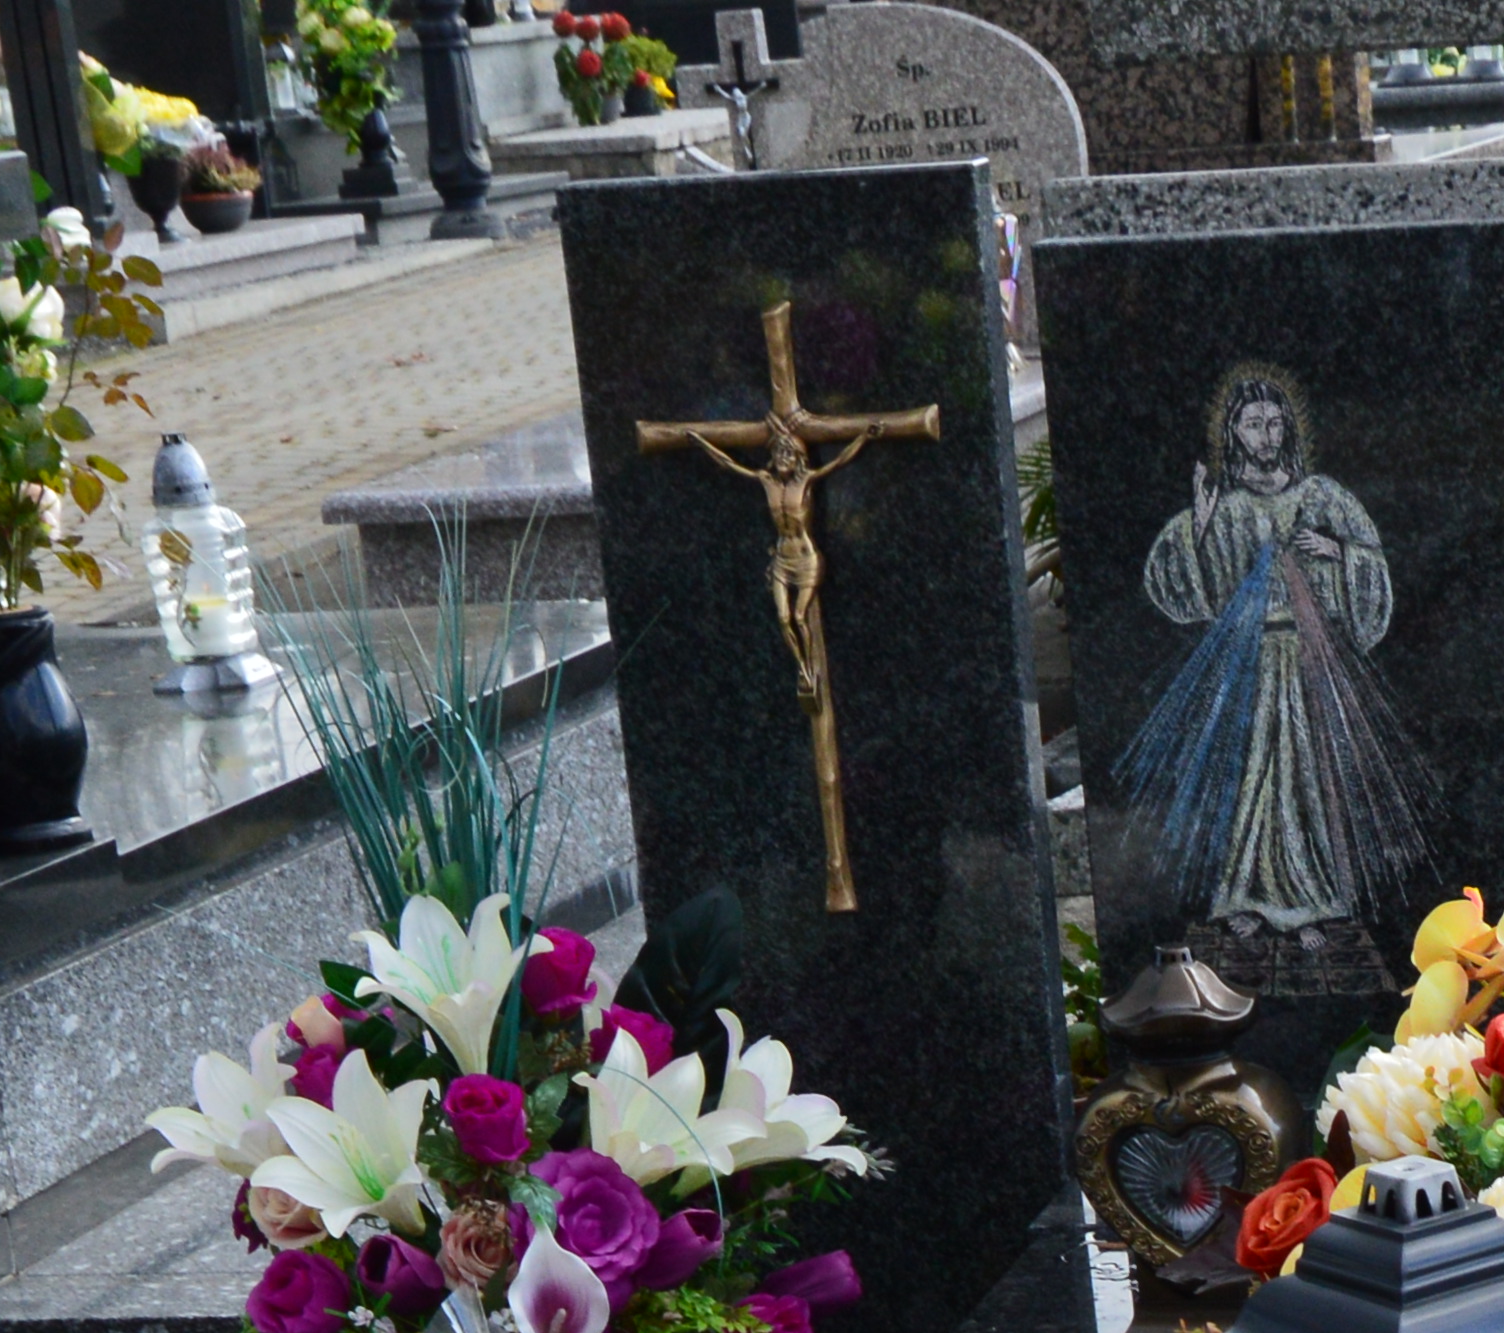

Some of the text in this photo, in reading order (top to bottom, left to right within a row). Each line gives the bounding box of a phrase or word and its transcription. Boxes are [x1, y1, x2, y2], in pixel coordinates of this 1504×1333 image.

[852, 106, 987, 134] Zofia BIEL
[959, 140, 977, 154] IX
